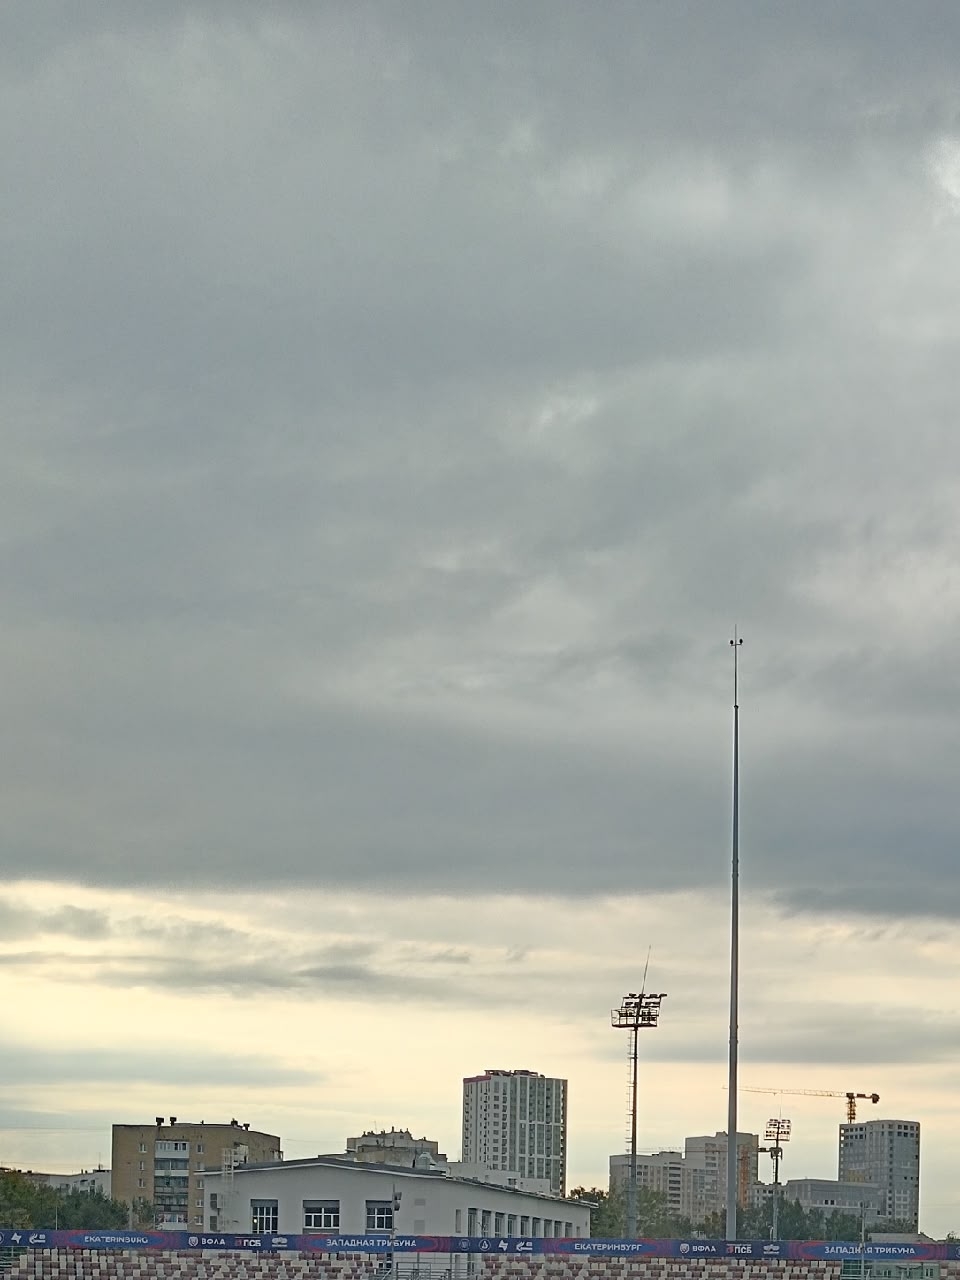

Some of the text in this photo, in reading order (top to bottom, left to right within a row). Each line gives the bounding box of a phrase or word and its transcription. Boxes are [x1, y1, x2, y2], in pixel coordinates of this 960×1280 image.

[84, 1235, 149, 1244] EKATERINBURG
[326, 1239, 417, 1248] ЗАПАДНАЯ ТРИБУНА
[574, 1243, 643, 1252] ЕКАТЕРИНБУРГ
[874, 1247, 916, 1255] ТРИБУНА
